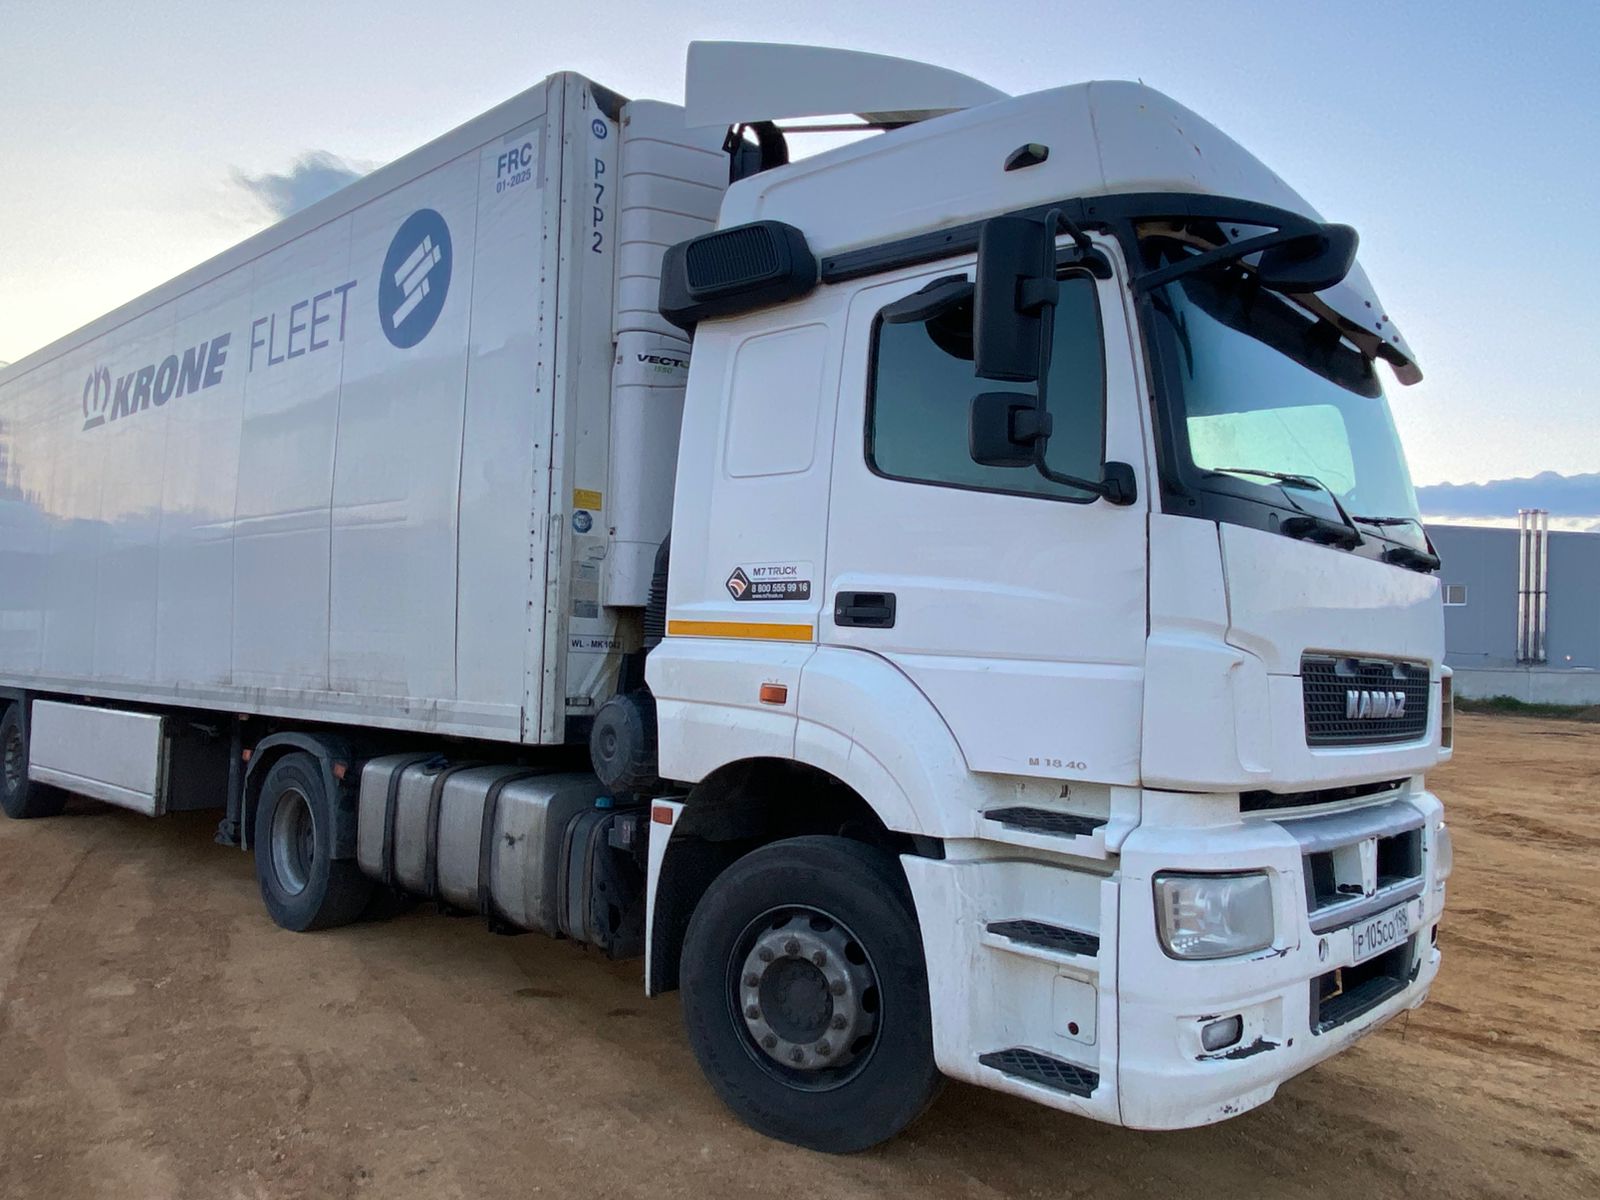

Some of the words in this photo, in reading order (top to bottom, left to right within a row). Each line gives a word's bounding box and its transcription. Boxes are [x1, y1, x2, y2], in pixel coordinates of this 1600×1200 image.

[497, 142, 532, 178] FRC
[496, 168, 531, 193] 01-2025
[110, 332, 231, 421] KRONE
[249, 280, 357, 372] FLEET
[753, 567, 766, 576] M7
[767, 566, 797, 575] TRUCK
[751, 584, 757, 593] 8
[772, 583, 785, 592] 555
[787, 583, 797, 592] 99
[798, 582, 808, 592] 16
[571, 639, 584, 648] WL
